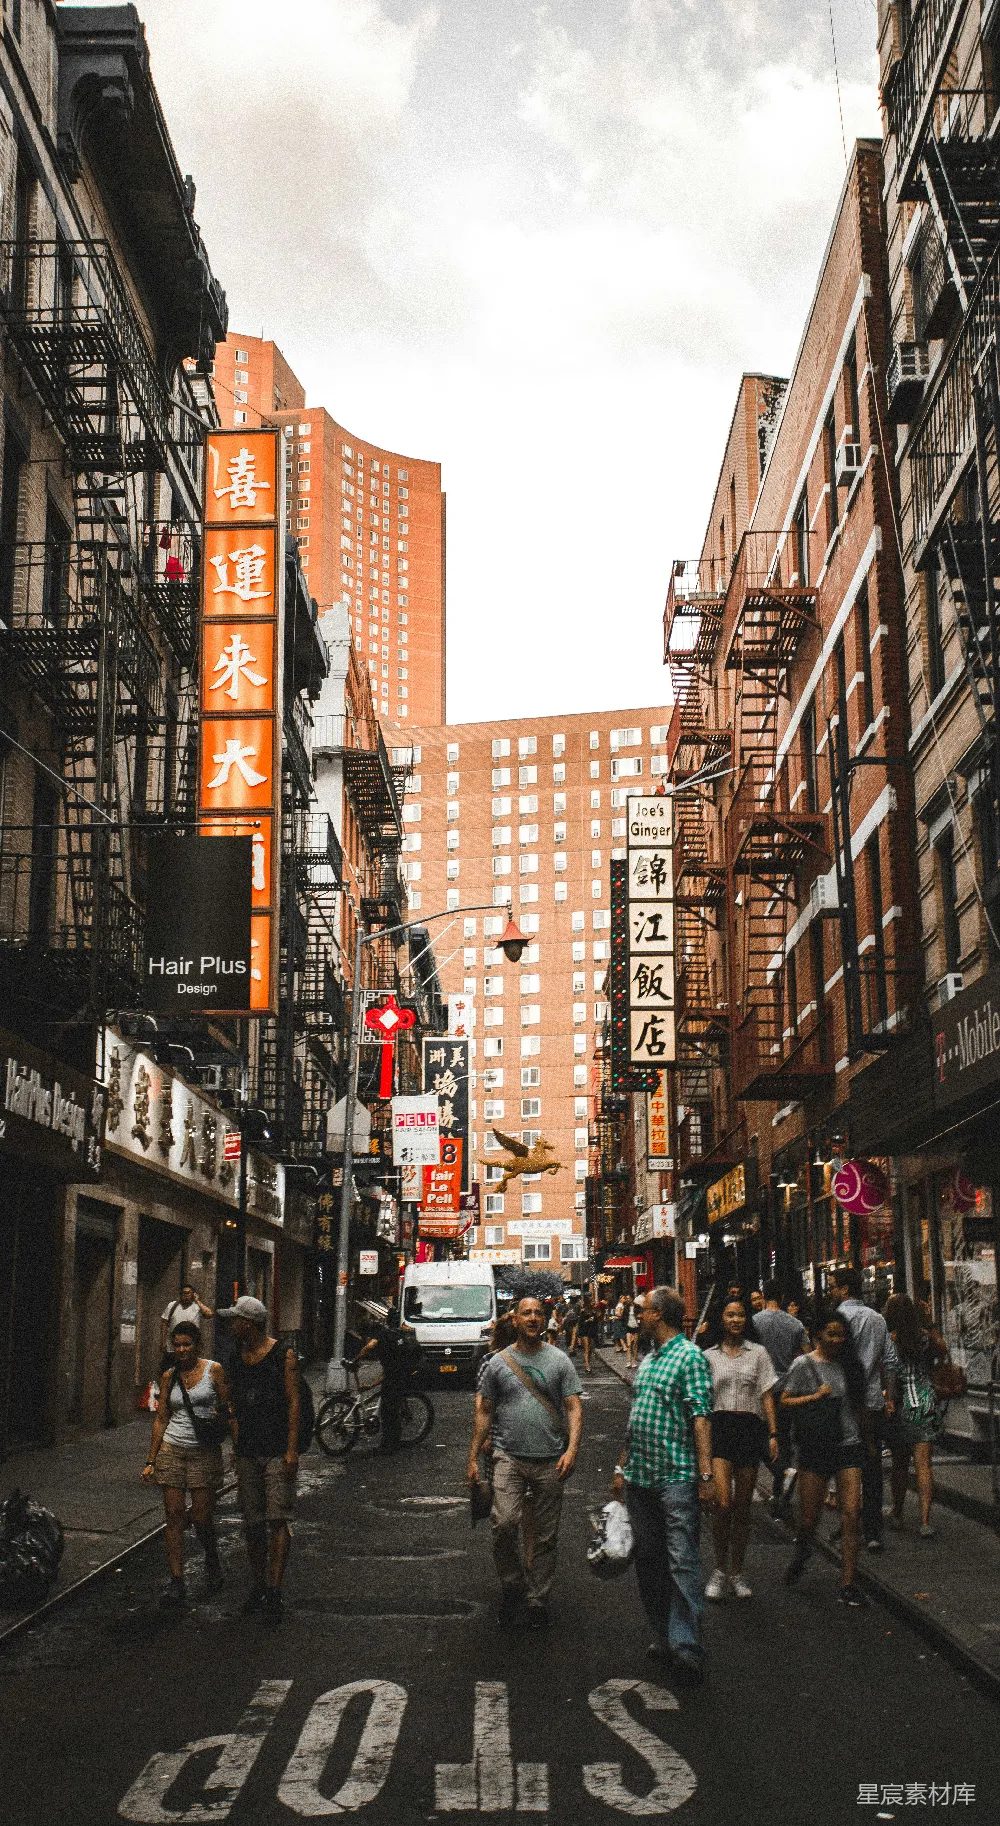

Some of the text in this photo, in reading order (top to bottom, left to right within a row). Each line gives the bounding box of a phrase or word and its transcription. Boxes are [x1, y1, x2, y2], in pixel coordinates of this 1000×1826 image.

[635, 801, 666, 817] Joe's
[630, 820, 672, 839] Ginger
[631, 853, 673, 1059] 錦江飯店
[148, 956, 247, 975] Hair Plus
[177, 983, 218, 996] Design
[395, 1113, 436, 1126] PELL
[442, 1143, 457, 1164] 8
[431, 1181, 449, 1192] Le
[426, 1193, 453, 1204] Pell
[117, 1677, 698, 1823] STOP
